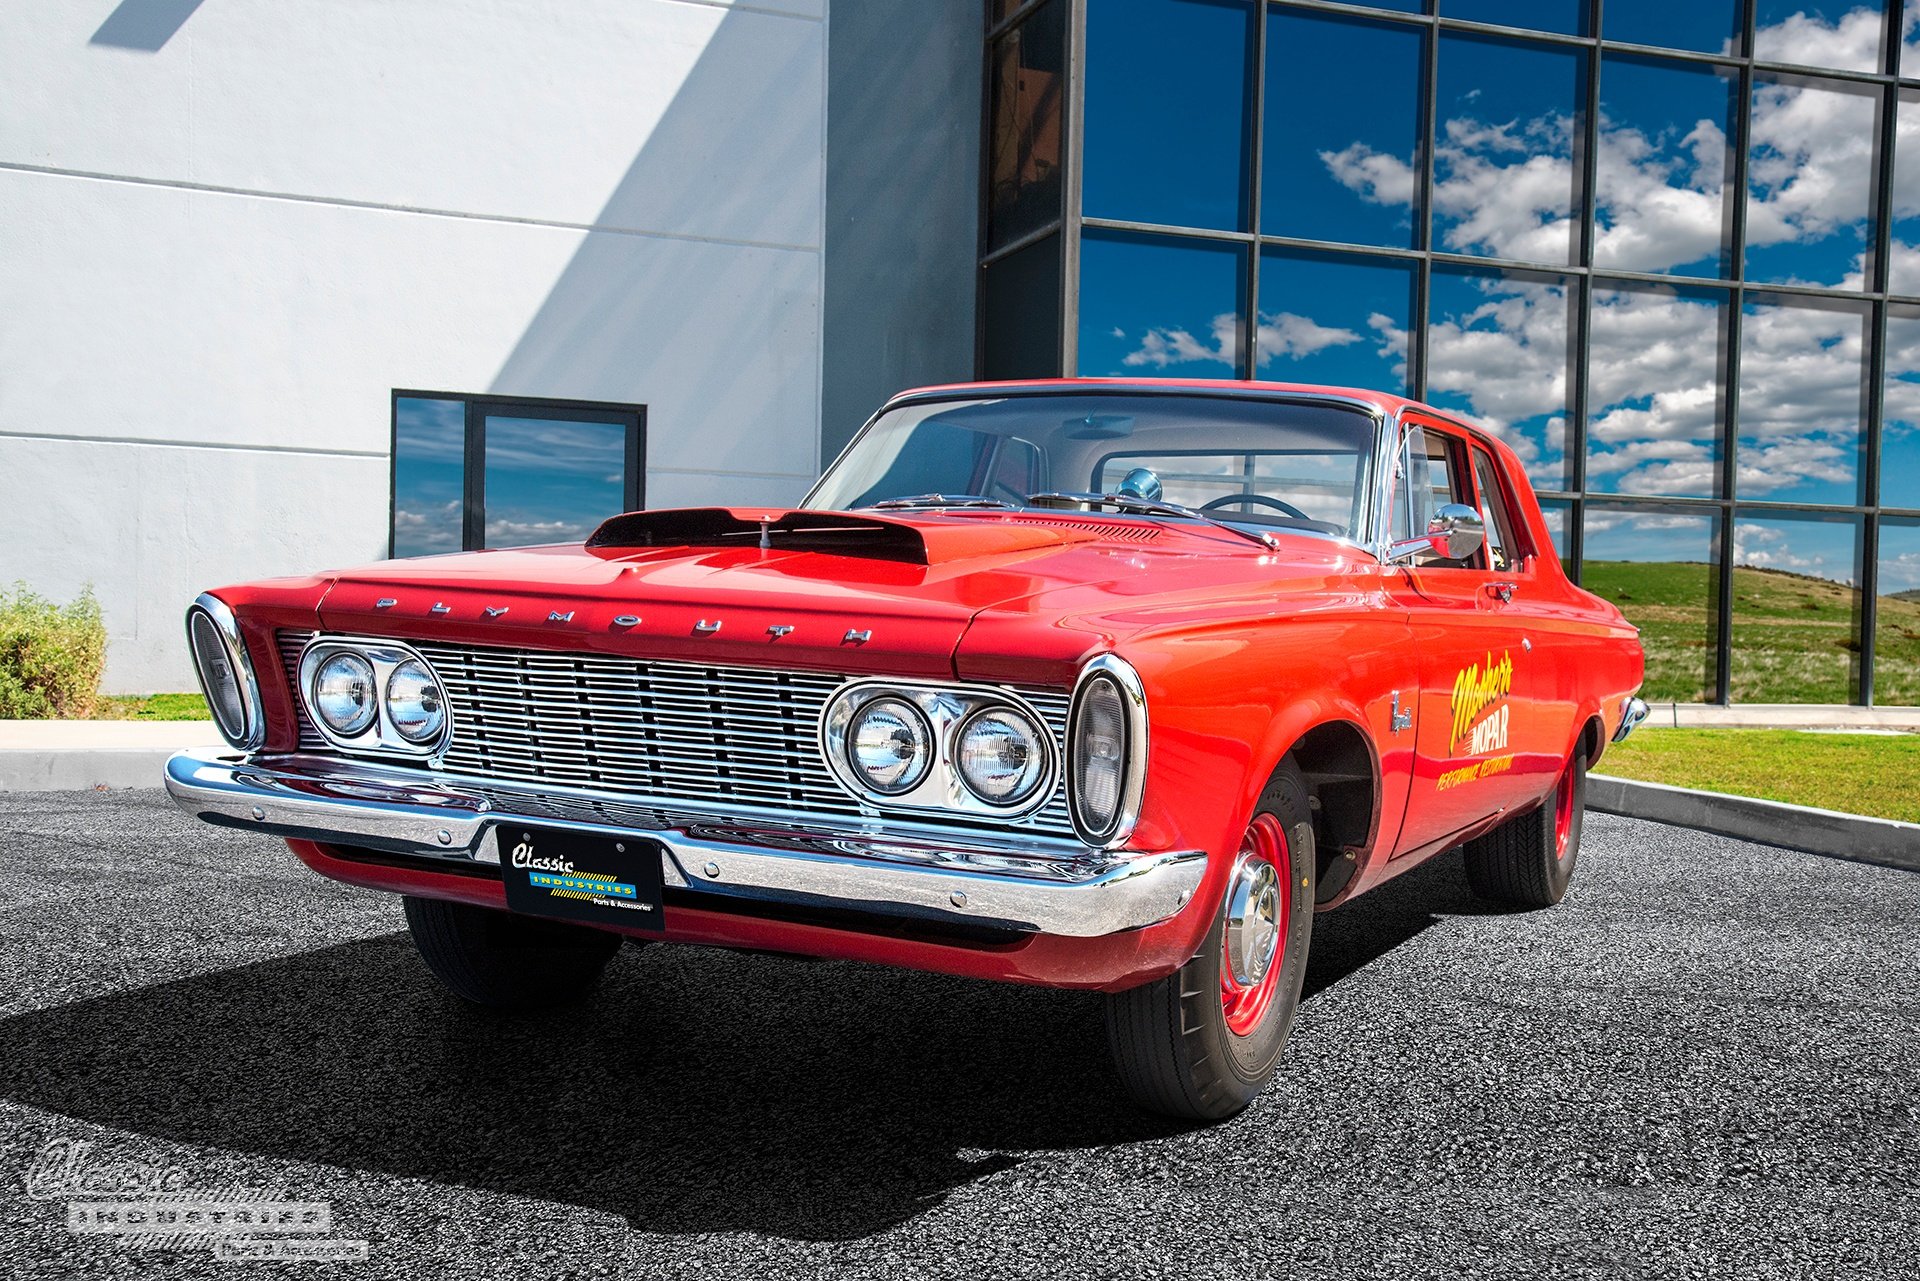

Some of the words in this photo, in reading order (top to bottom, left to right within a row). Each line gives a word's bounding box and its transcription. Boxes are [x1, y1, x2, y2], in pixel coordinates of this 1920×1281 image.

[376, 597, 873, 643] PLYMOUTH
[1471, 704, 1510, 756] MOPAR
[511, 842, 575, 873] Classic
[533, 876, 634, 895] INDUSTRIES
[593, 897, 610, 907] Parts
[610, 899, 616, 907] &
[616, 900, 653, 912] Accessories
